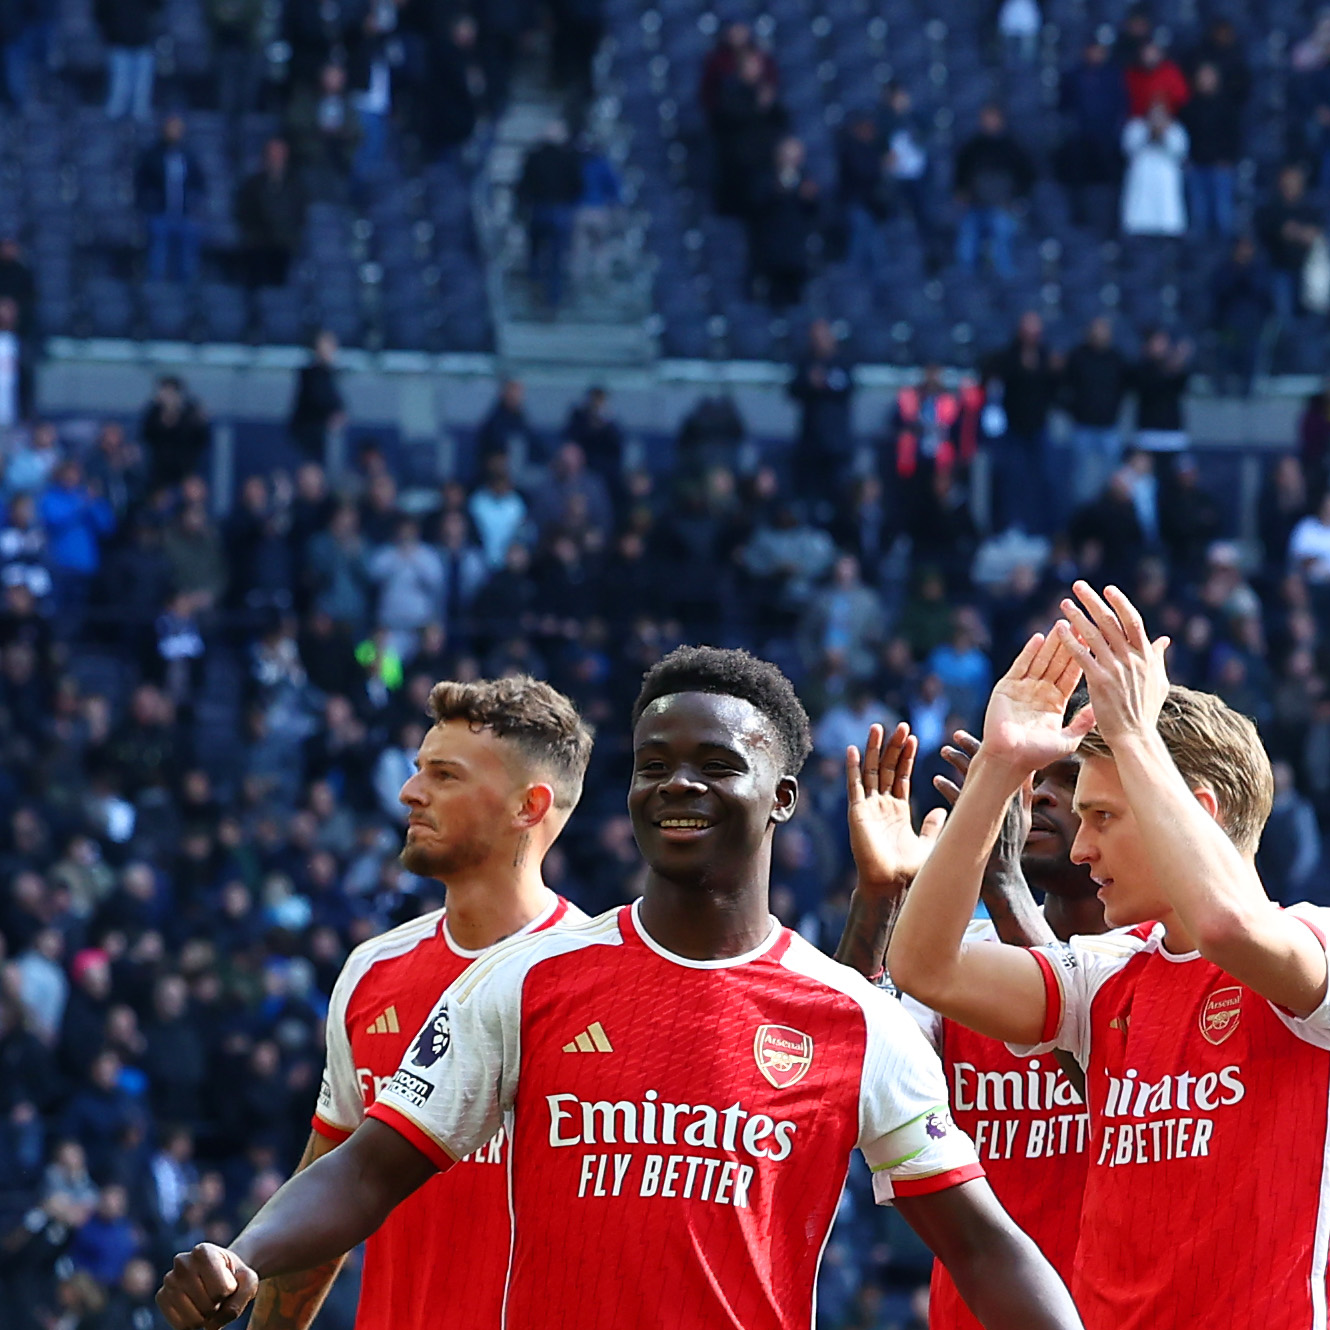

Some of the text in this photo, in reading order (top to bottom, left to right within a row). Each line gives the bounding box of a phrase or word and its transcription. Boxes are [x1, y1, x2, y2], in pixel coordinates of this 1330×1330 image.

[1207, 995, 1240, 1010] Arsenal
[764, 1033, 805, 1051] Arsenal
[953, 1059, 1083, 1111] Emira
[545, 1089, 798, 1162] Emirates
[975, 1120, 1020, 1160] FLY
[1025, 1113, 1090, 1158] BETT
[1114, 1117, 1214, 1165] BETTER
[577, 1154, 754, 1208] FLY BETTER
